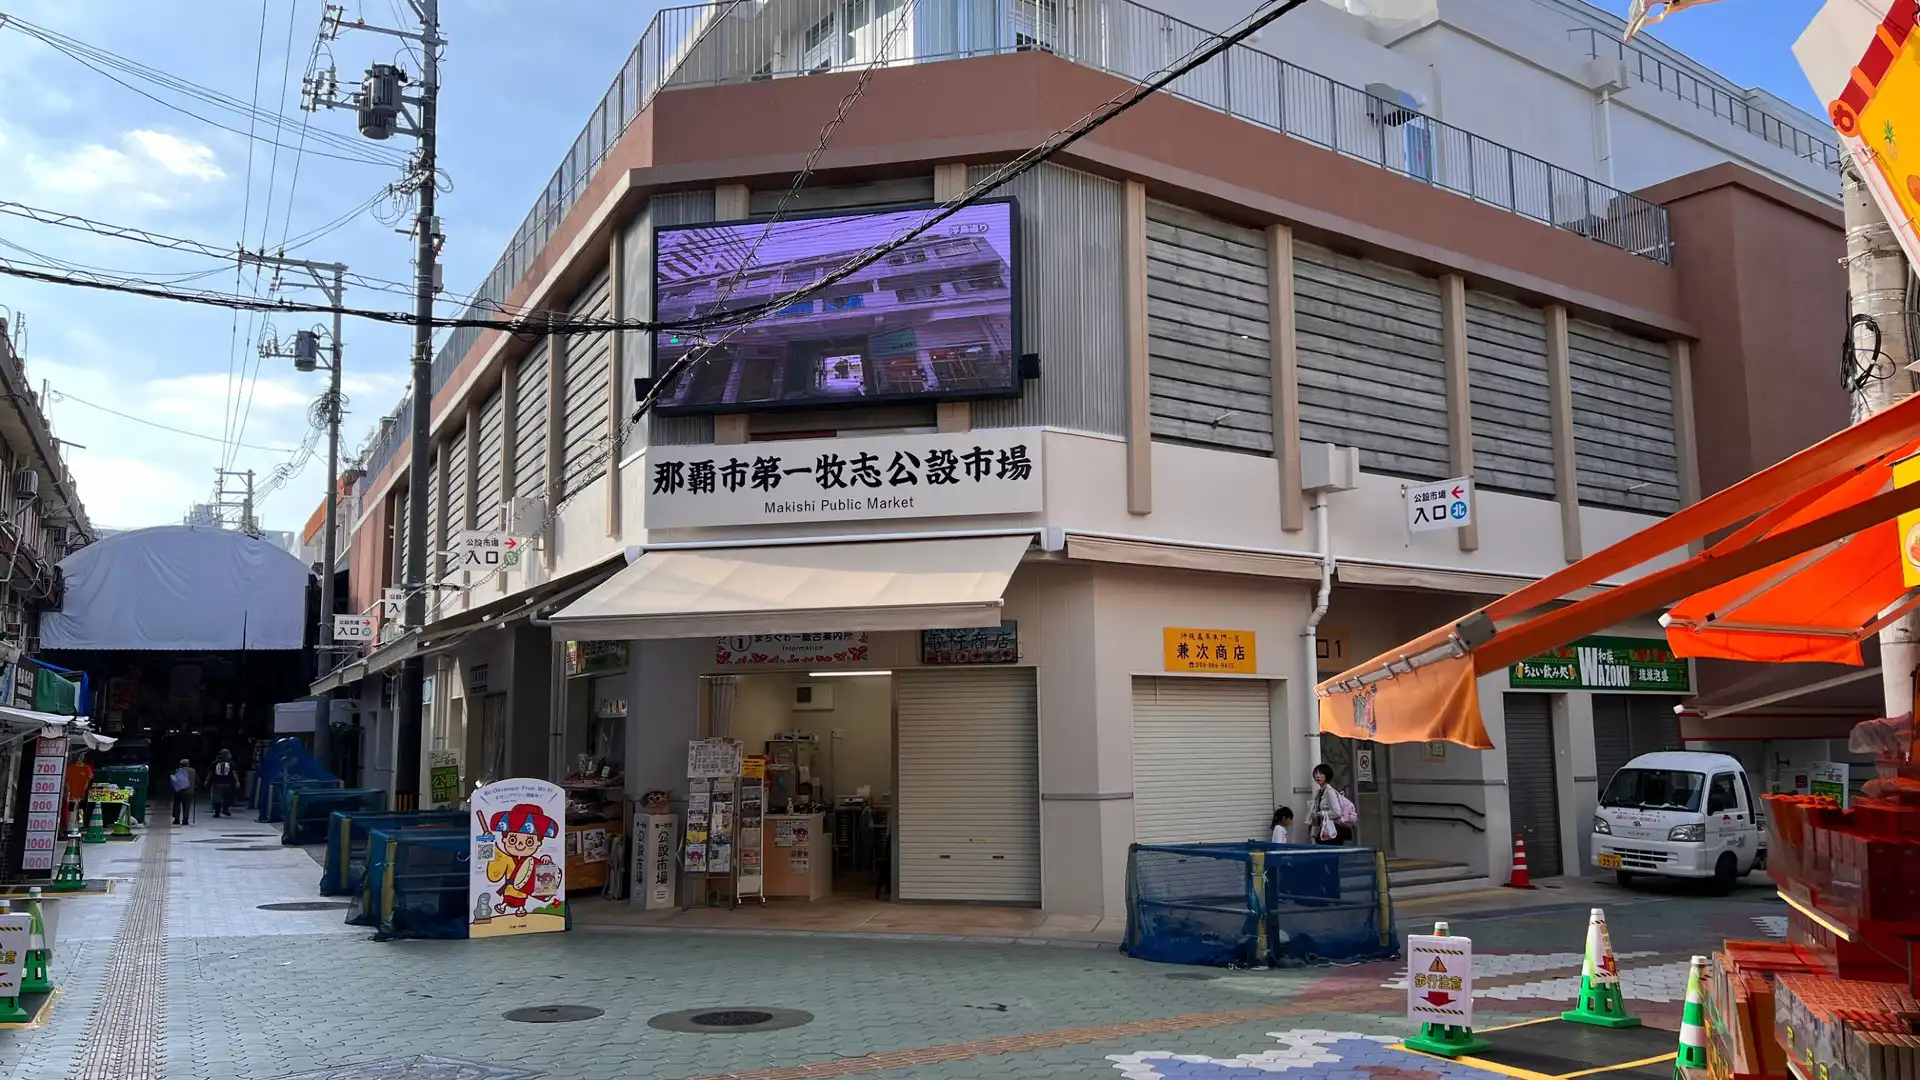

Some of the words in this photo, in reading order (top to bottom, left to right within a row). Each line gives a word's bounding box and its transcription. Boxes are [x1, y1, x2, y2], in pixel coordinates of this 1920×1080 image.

[652, 444, 1032, 495] 那覇市第一牧志公設市場
[764, 501, 815, 514] Makishi
[821, 498, 862, 511] Public
[867, 496, 914, 509] Market
[1413, 490, 1447, 503] 公設市場
[1413, 505, 1447, 524] 入口
[1452, 503, 1466, 517] 北
[466, 538, 499, 547] 公設市場
[465, 550, 499, 564] 入口
[337, 627, 360, 636] 入口
[1176, 642, 1245, 660] 兼次商店
[1524, 663, 1569, 679] ちょい飲み処
[1578, 646, 1630, 687] WAZOKU
[36, 763, 57, 773] 700
[656, 830, 669, 884] 公設市場
[1414, 972, 1463, 991] 歩行注意
